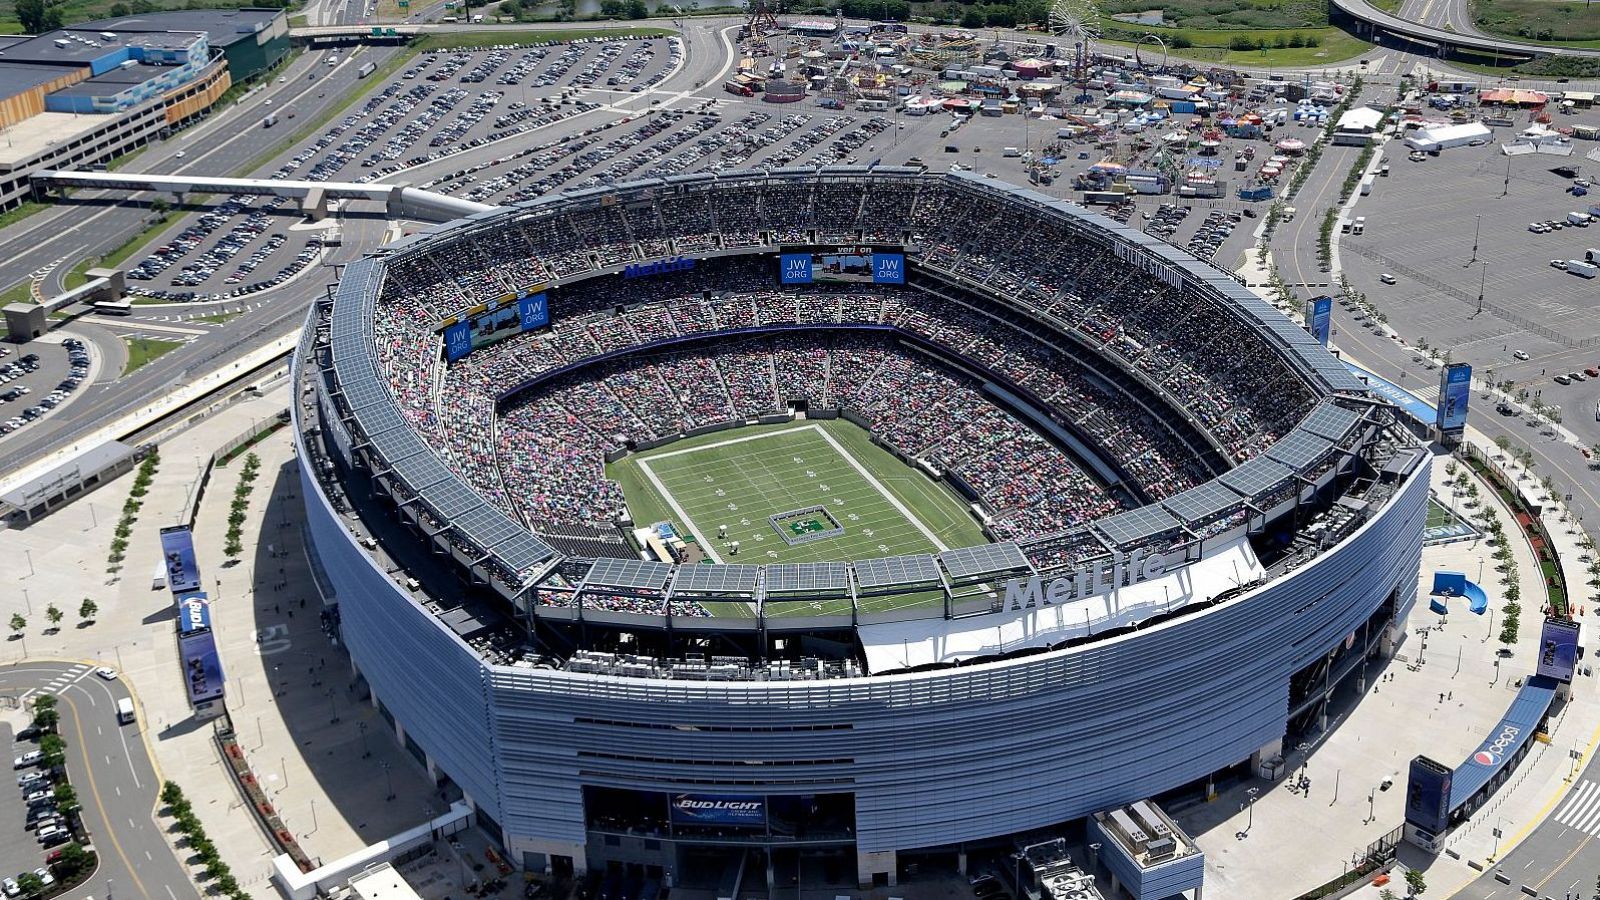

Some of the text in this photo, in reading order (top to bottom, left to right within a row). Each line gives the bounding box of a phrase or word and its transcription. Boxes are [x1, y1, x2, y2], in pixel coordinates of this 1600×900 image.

[786, 260, 806, 270] JW
[879, 260, 898, 270] JW
[786, 271, 807, 279] .ORG
[877, 271, 899, 279] .ORG
[525, 301, 542, 315] JW
[524, 312, 544, 325] .ORG
[451, 329, 466, 345] JW
[450, 341, 468, 354] .ORG
[1002, 548, 1167, 613] MetLife
[189, 601, 202, 623] BUD
[1489, 725, 1520, 755] pepsi
[680, 800, 762, 810] BUD LIGHT
